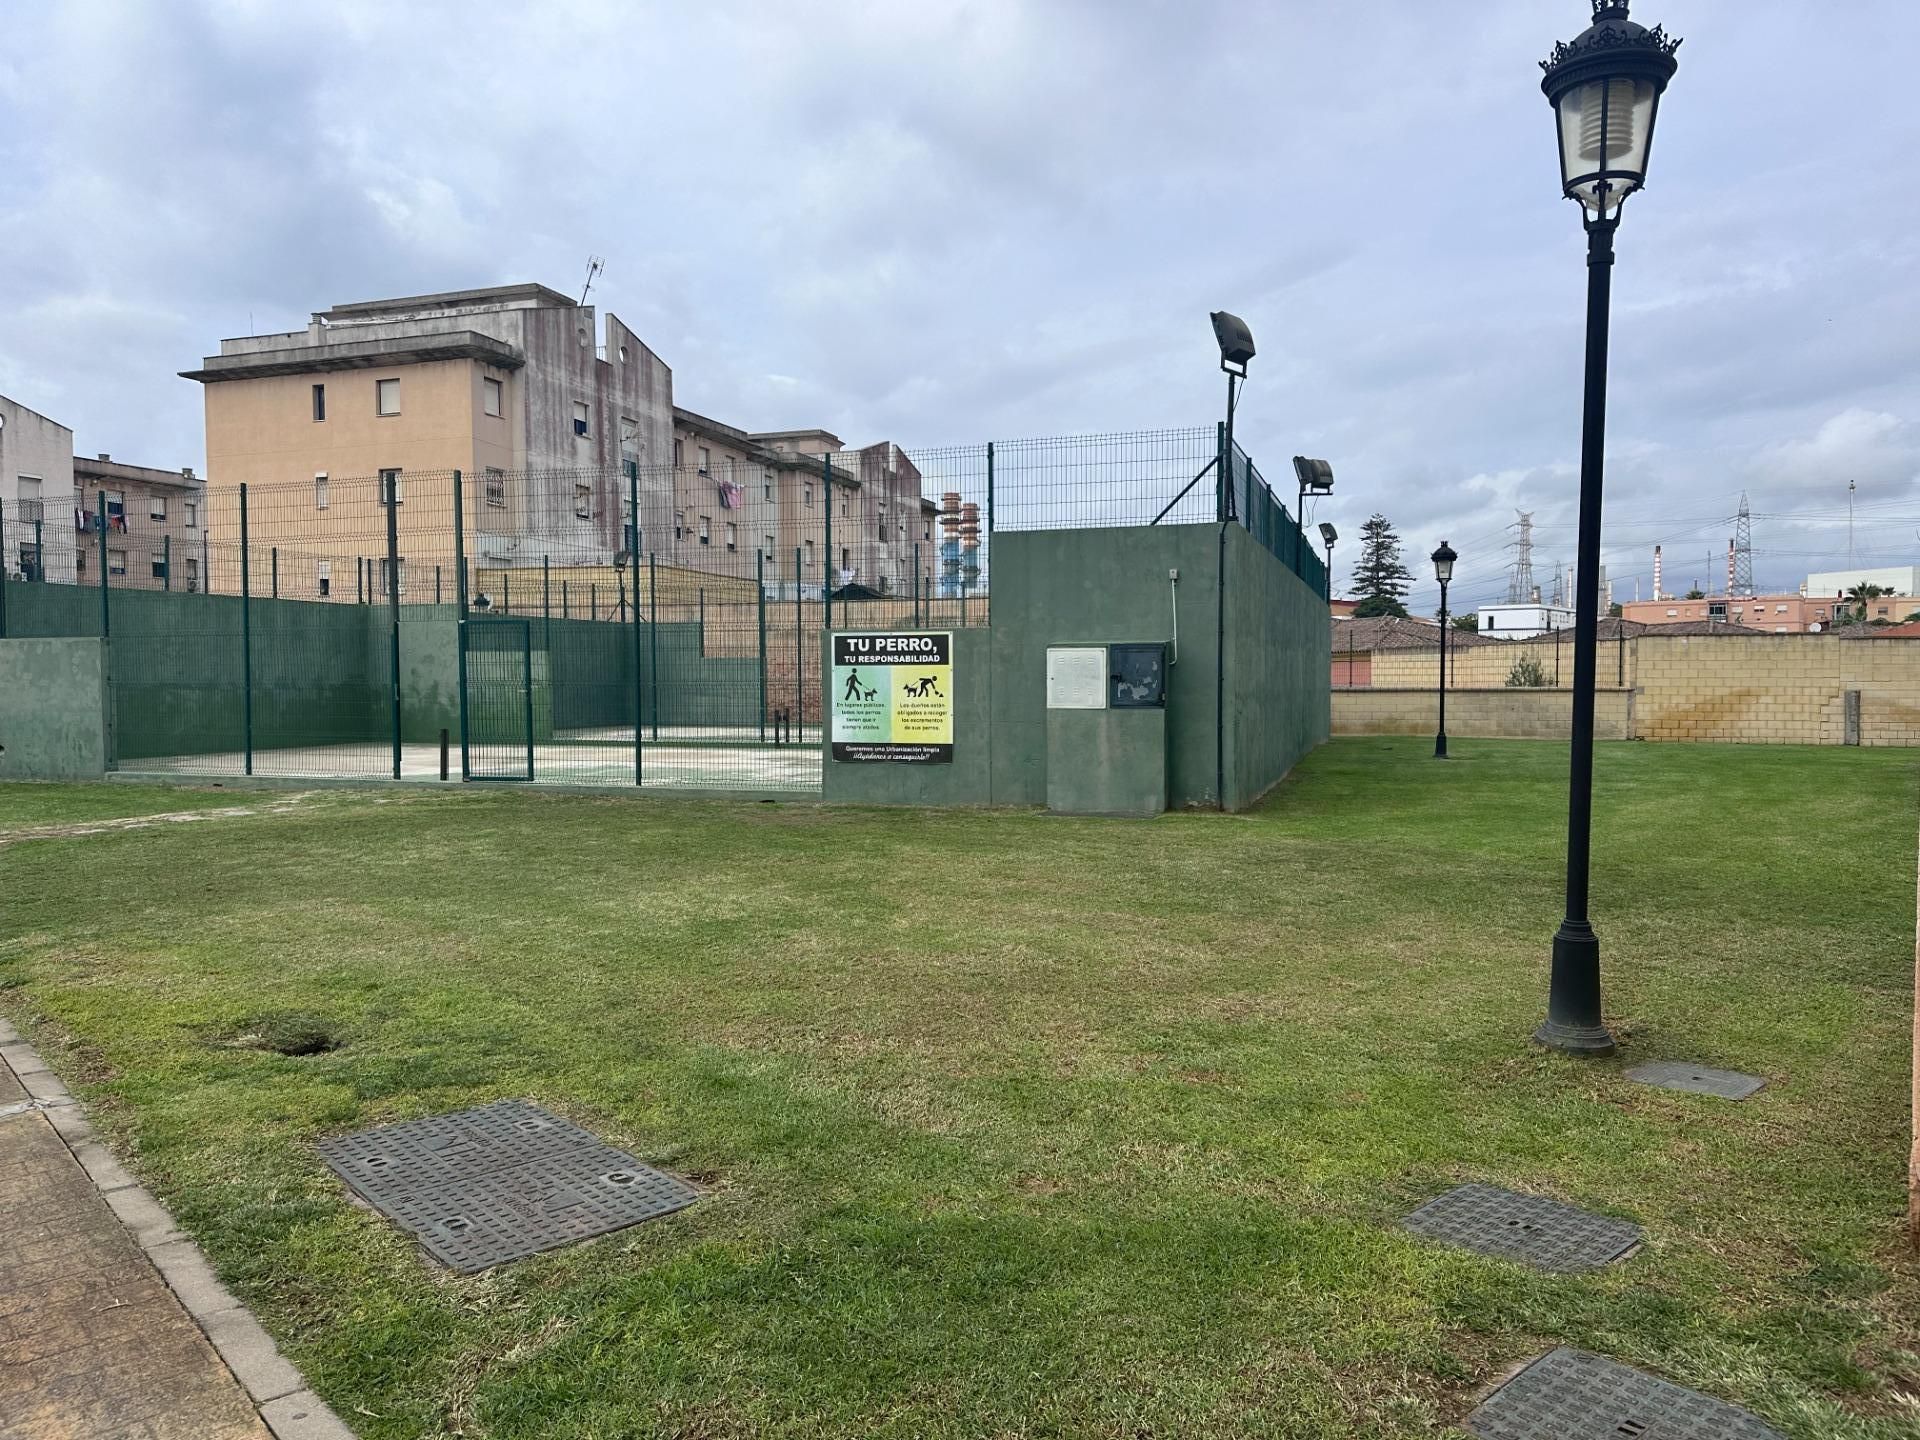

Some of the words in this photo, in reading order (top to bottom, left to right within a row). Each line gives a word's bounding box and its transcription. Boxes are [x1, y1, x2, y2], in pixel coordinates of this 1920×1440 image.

[847, 638, 870, 652] TU
[875, 637, 938, 654] PERRO,
[844, 655, 856, 663] TU
[858, 654, 941, 663] RESPONSABILIDAD
